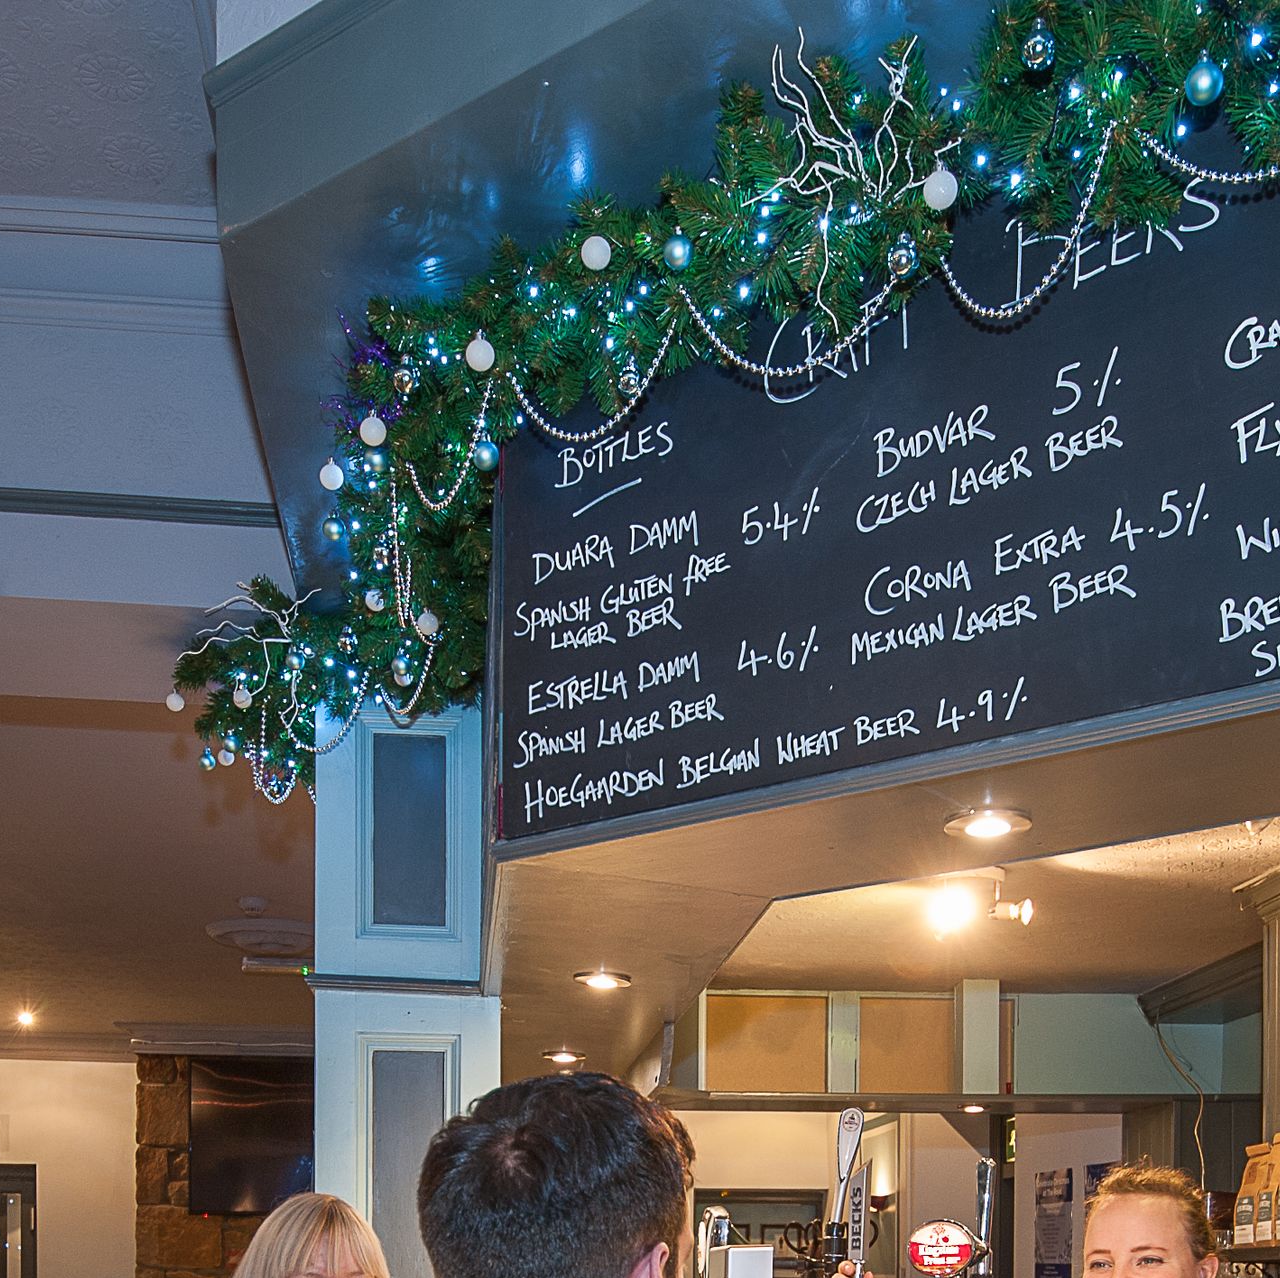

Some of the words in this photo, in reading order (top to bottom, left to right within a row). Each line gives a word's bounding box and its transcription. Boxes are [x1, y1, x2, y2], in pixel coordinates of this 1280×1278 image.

[555, 421, 674, 489] BOTTLES
[856, 480, 936, 533] CZECH
[948, 446, 1033, 506] LAGER
[1045, 415, 1124, 472] BEER
[874, 405, 996, 478] BUDVAR
[533, 538, 615, 585] DUARA
[629, 511, 700, 555] DAMM
[741, 487, 821, 546] 5.4%
[865, 560, 973, 615] CORONA
[994, 526, 1086, 575] EXTRA
[1110, 484, 1210, 551] 4.5%
[513, 594, 591, 642] SPANISH
[600, 575, 673, 616] GLUTEN
[550, 621, 617, 651] LAGER
[626, 597, 683, 639] BEER
[850, 614, 945, 665] MEXICAN
[952, 594, 1038, 642] LAGER
[1049, 564, 1137, 612] BEER
[528, 671, 628, 715] ESTRELLA
[638, 650, 701, 694] DAMM
[737, 626, 820, 677] 4.6%
[513, 724, 587, 769] SPANISH
[597, 711, 665, 748] LAGER
[669, 693, 725, 730] BEER
[676, 738, 761, 790] BELGIAN
[776, 724, 847, 766] WHEAT
[854, 707, 922, 747] BEER
[935, 676, 1029, 734] 4.9%
[851, 1186, 862, 1250] BECK'S
